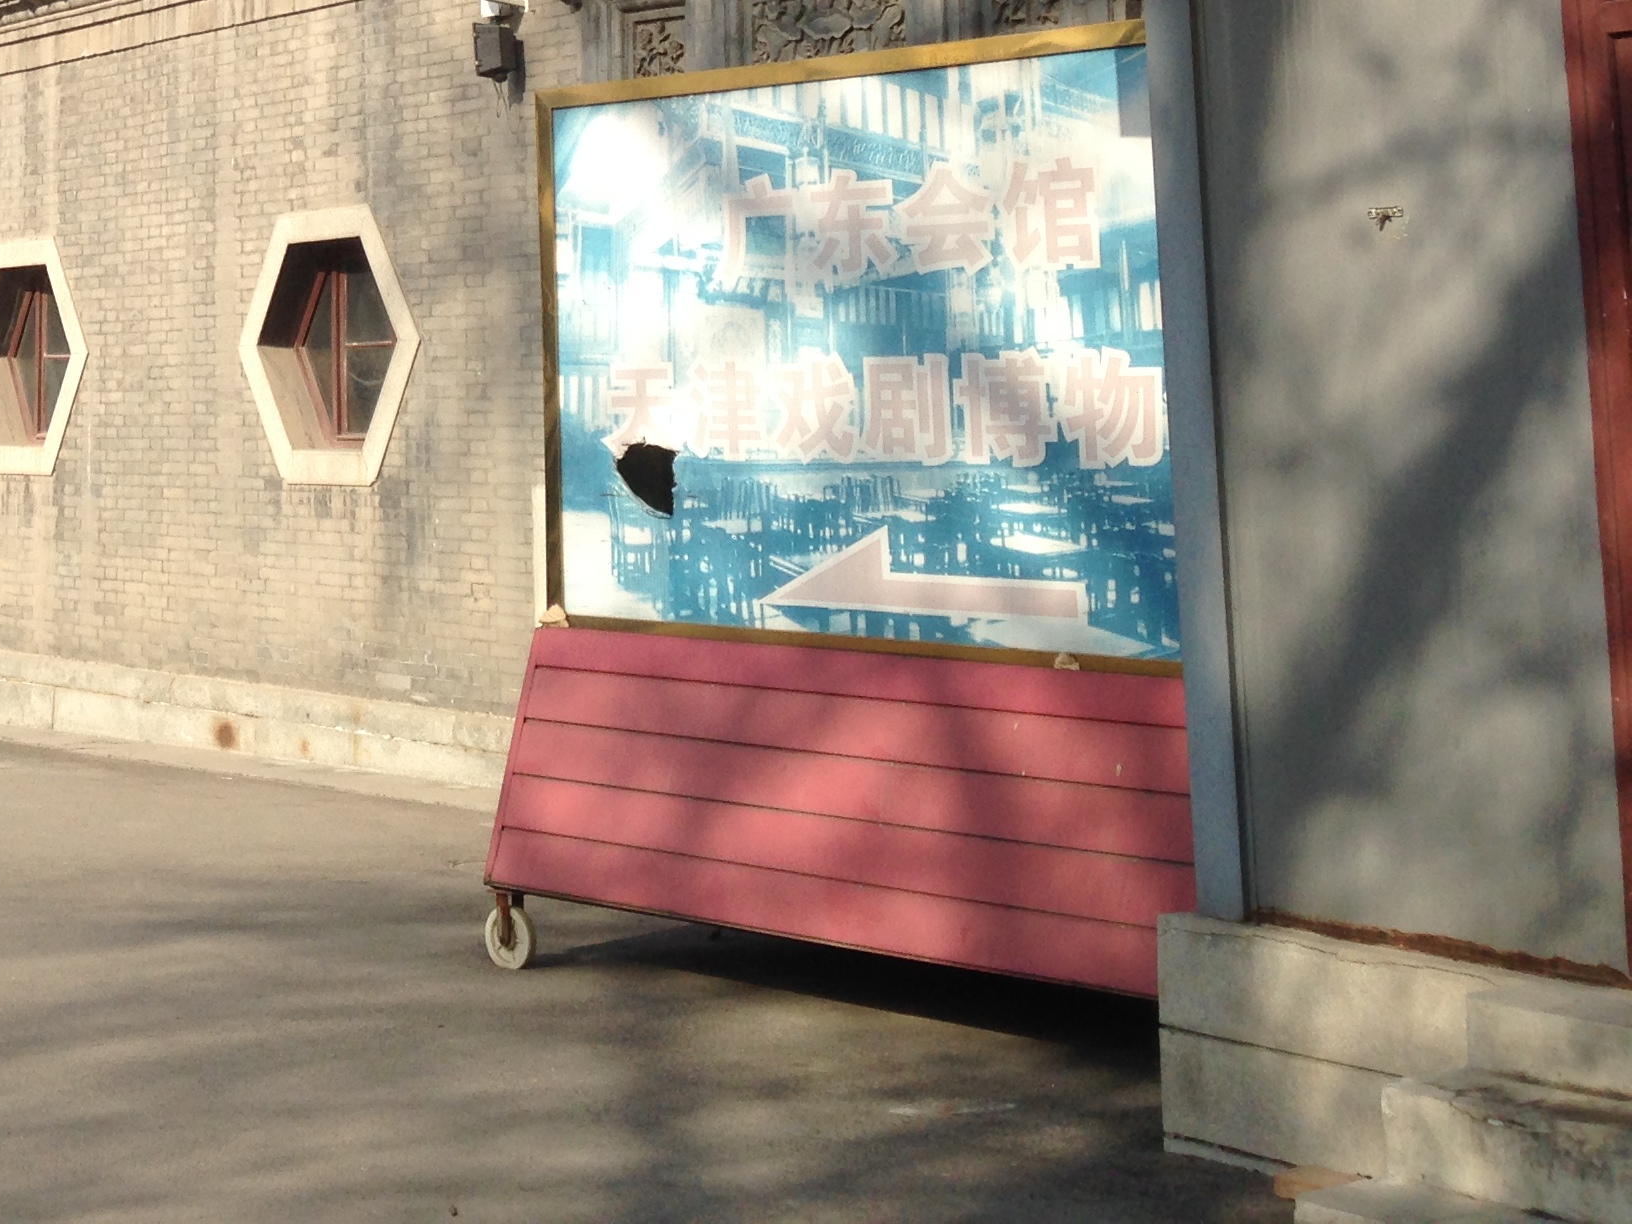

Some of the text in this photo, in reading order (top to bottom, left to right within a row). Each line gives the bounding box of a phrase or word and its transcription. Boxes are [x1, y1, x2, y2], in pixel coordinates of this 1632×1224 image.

[722, 156, 1097, 277] 广东会馆
[606, 355, 1158, 464] 天津戏剧博物
